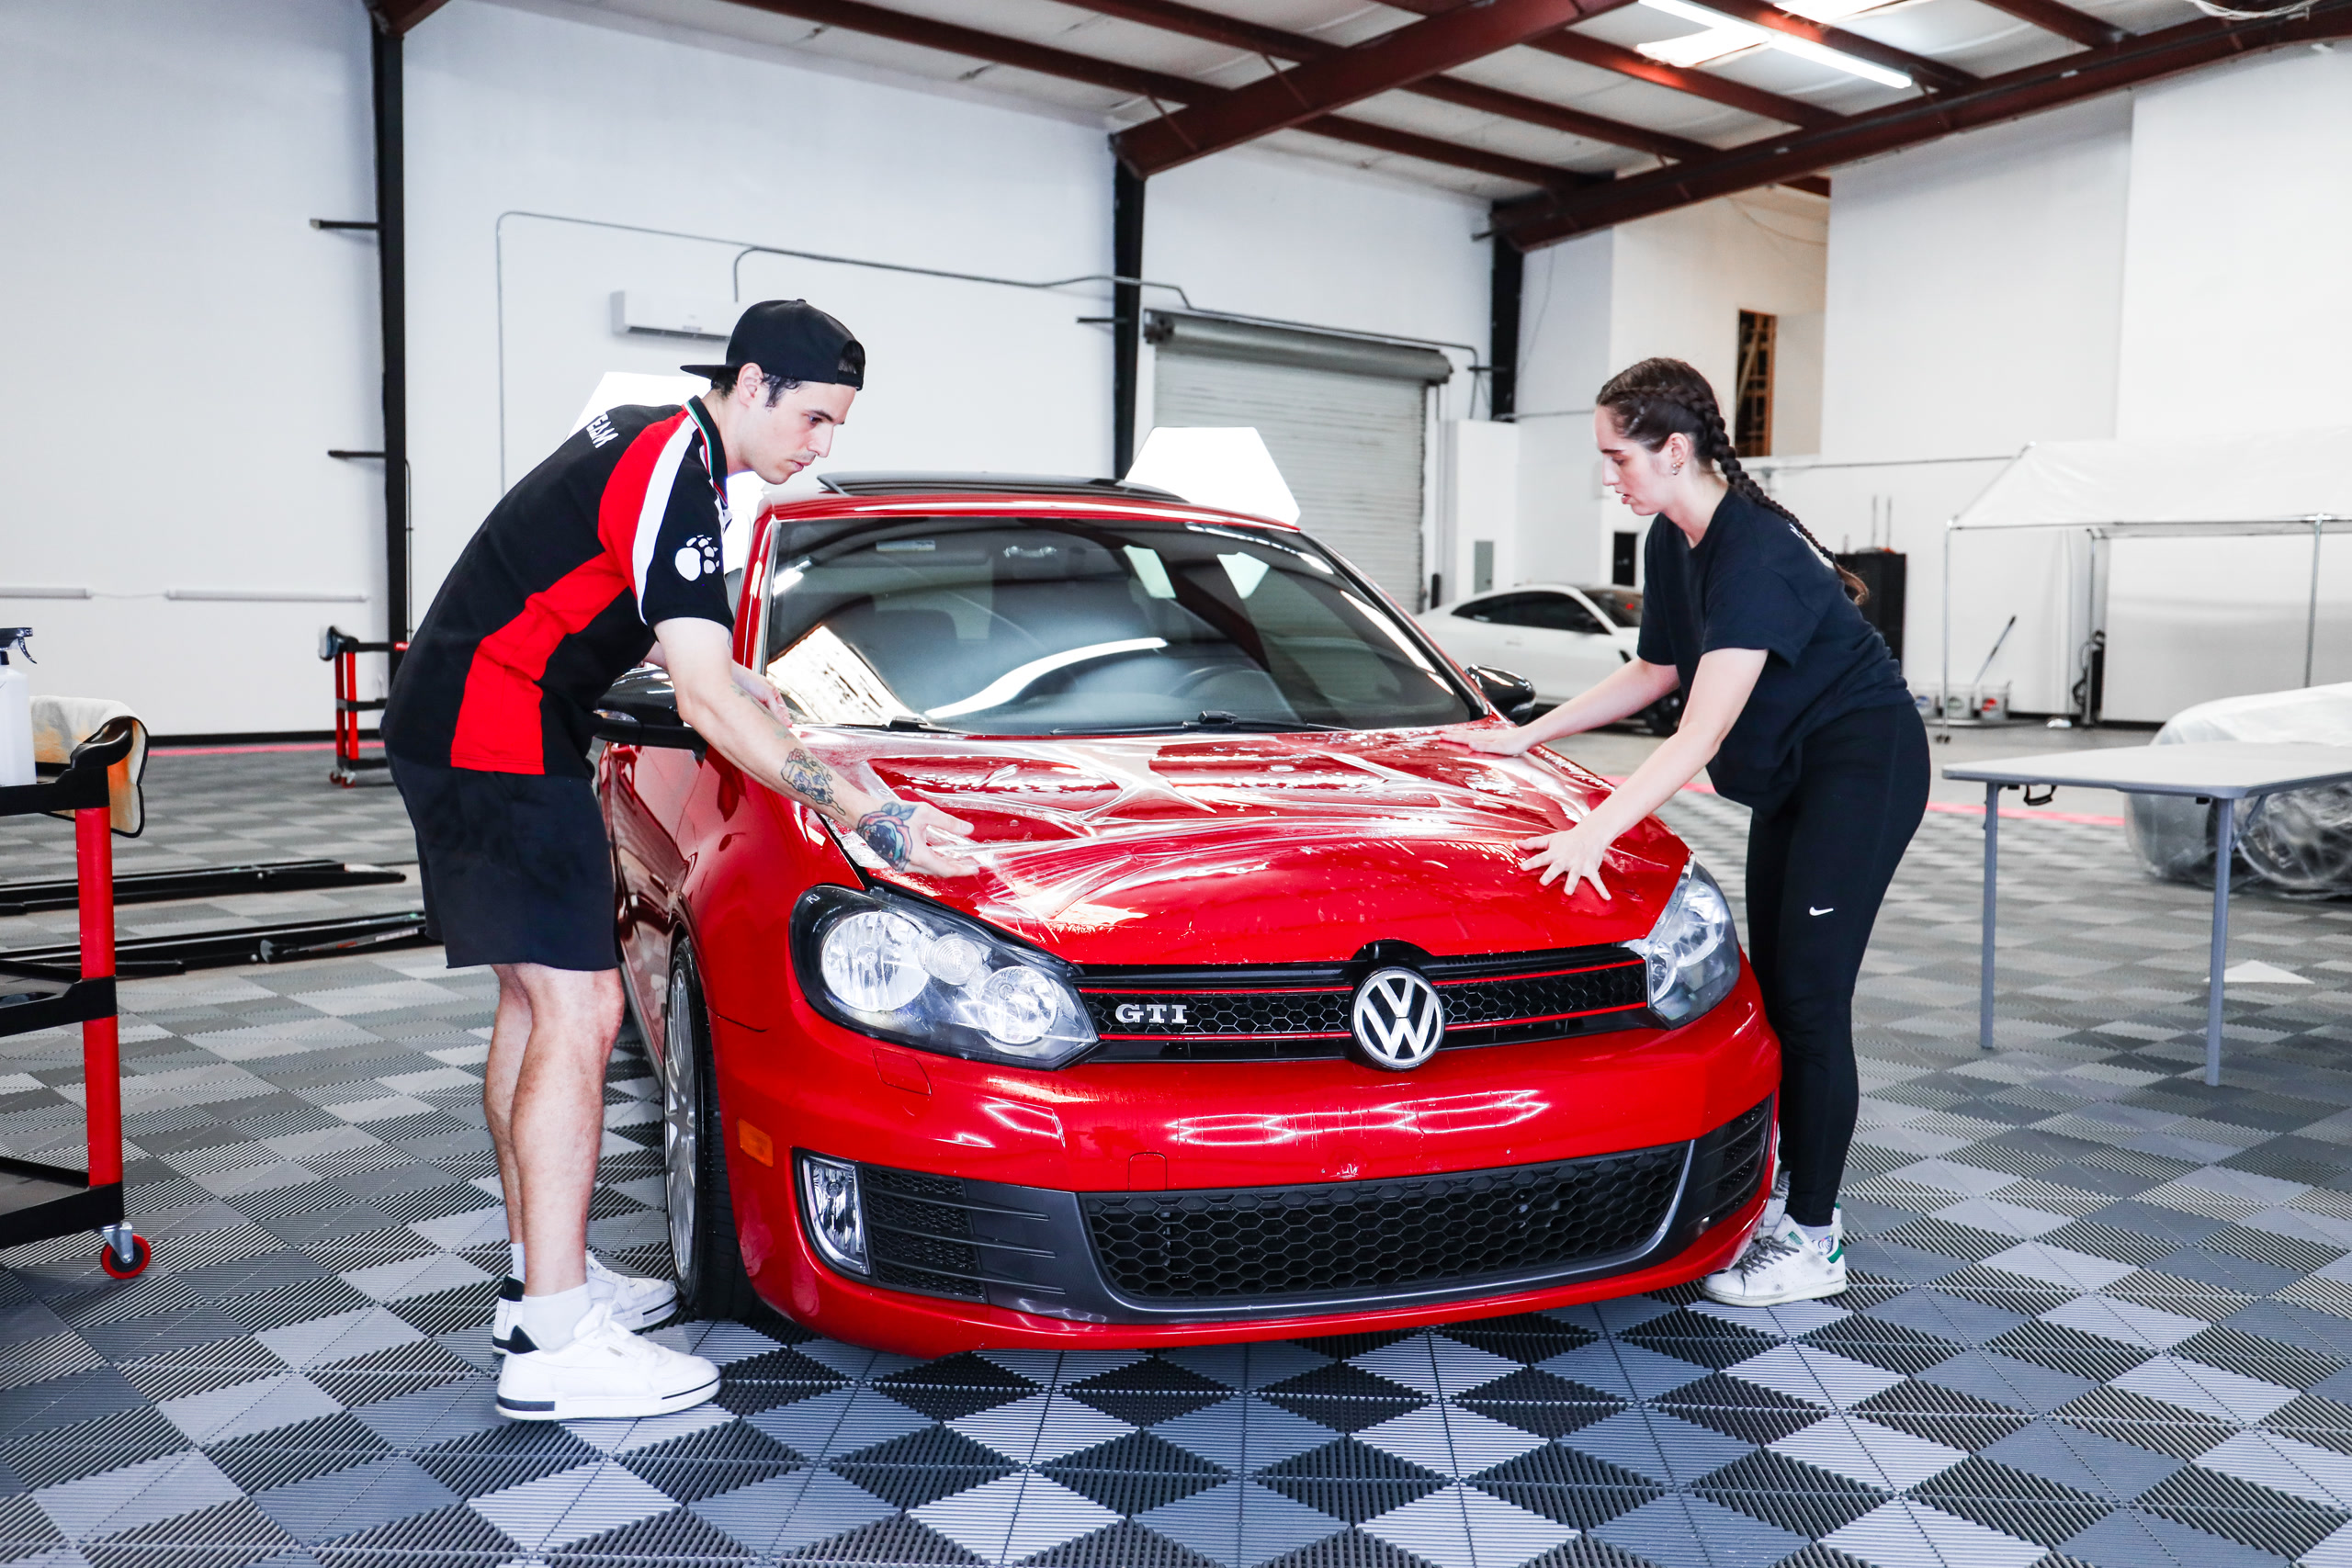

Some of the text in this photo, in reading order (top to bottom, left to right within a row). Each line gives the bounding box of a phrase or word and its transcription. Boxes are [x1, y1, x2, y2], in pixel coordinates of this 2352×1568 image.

[585, 412, 619, 449] EAM
[1114, 1003, 1188, 1024] GTI
[1354, 969, 1442, 1066] VW
